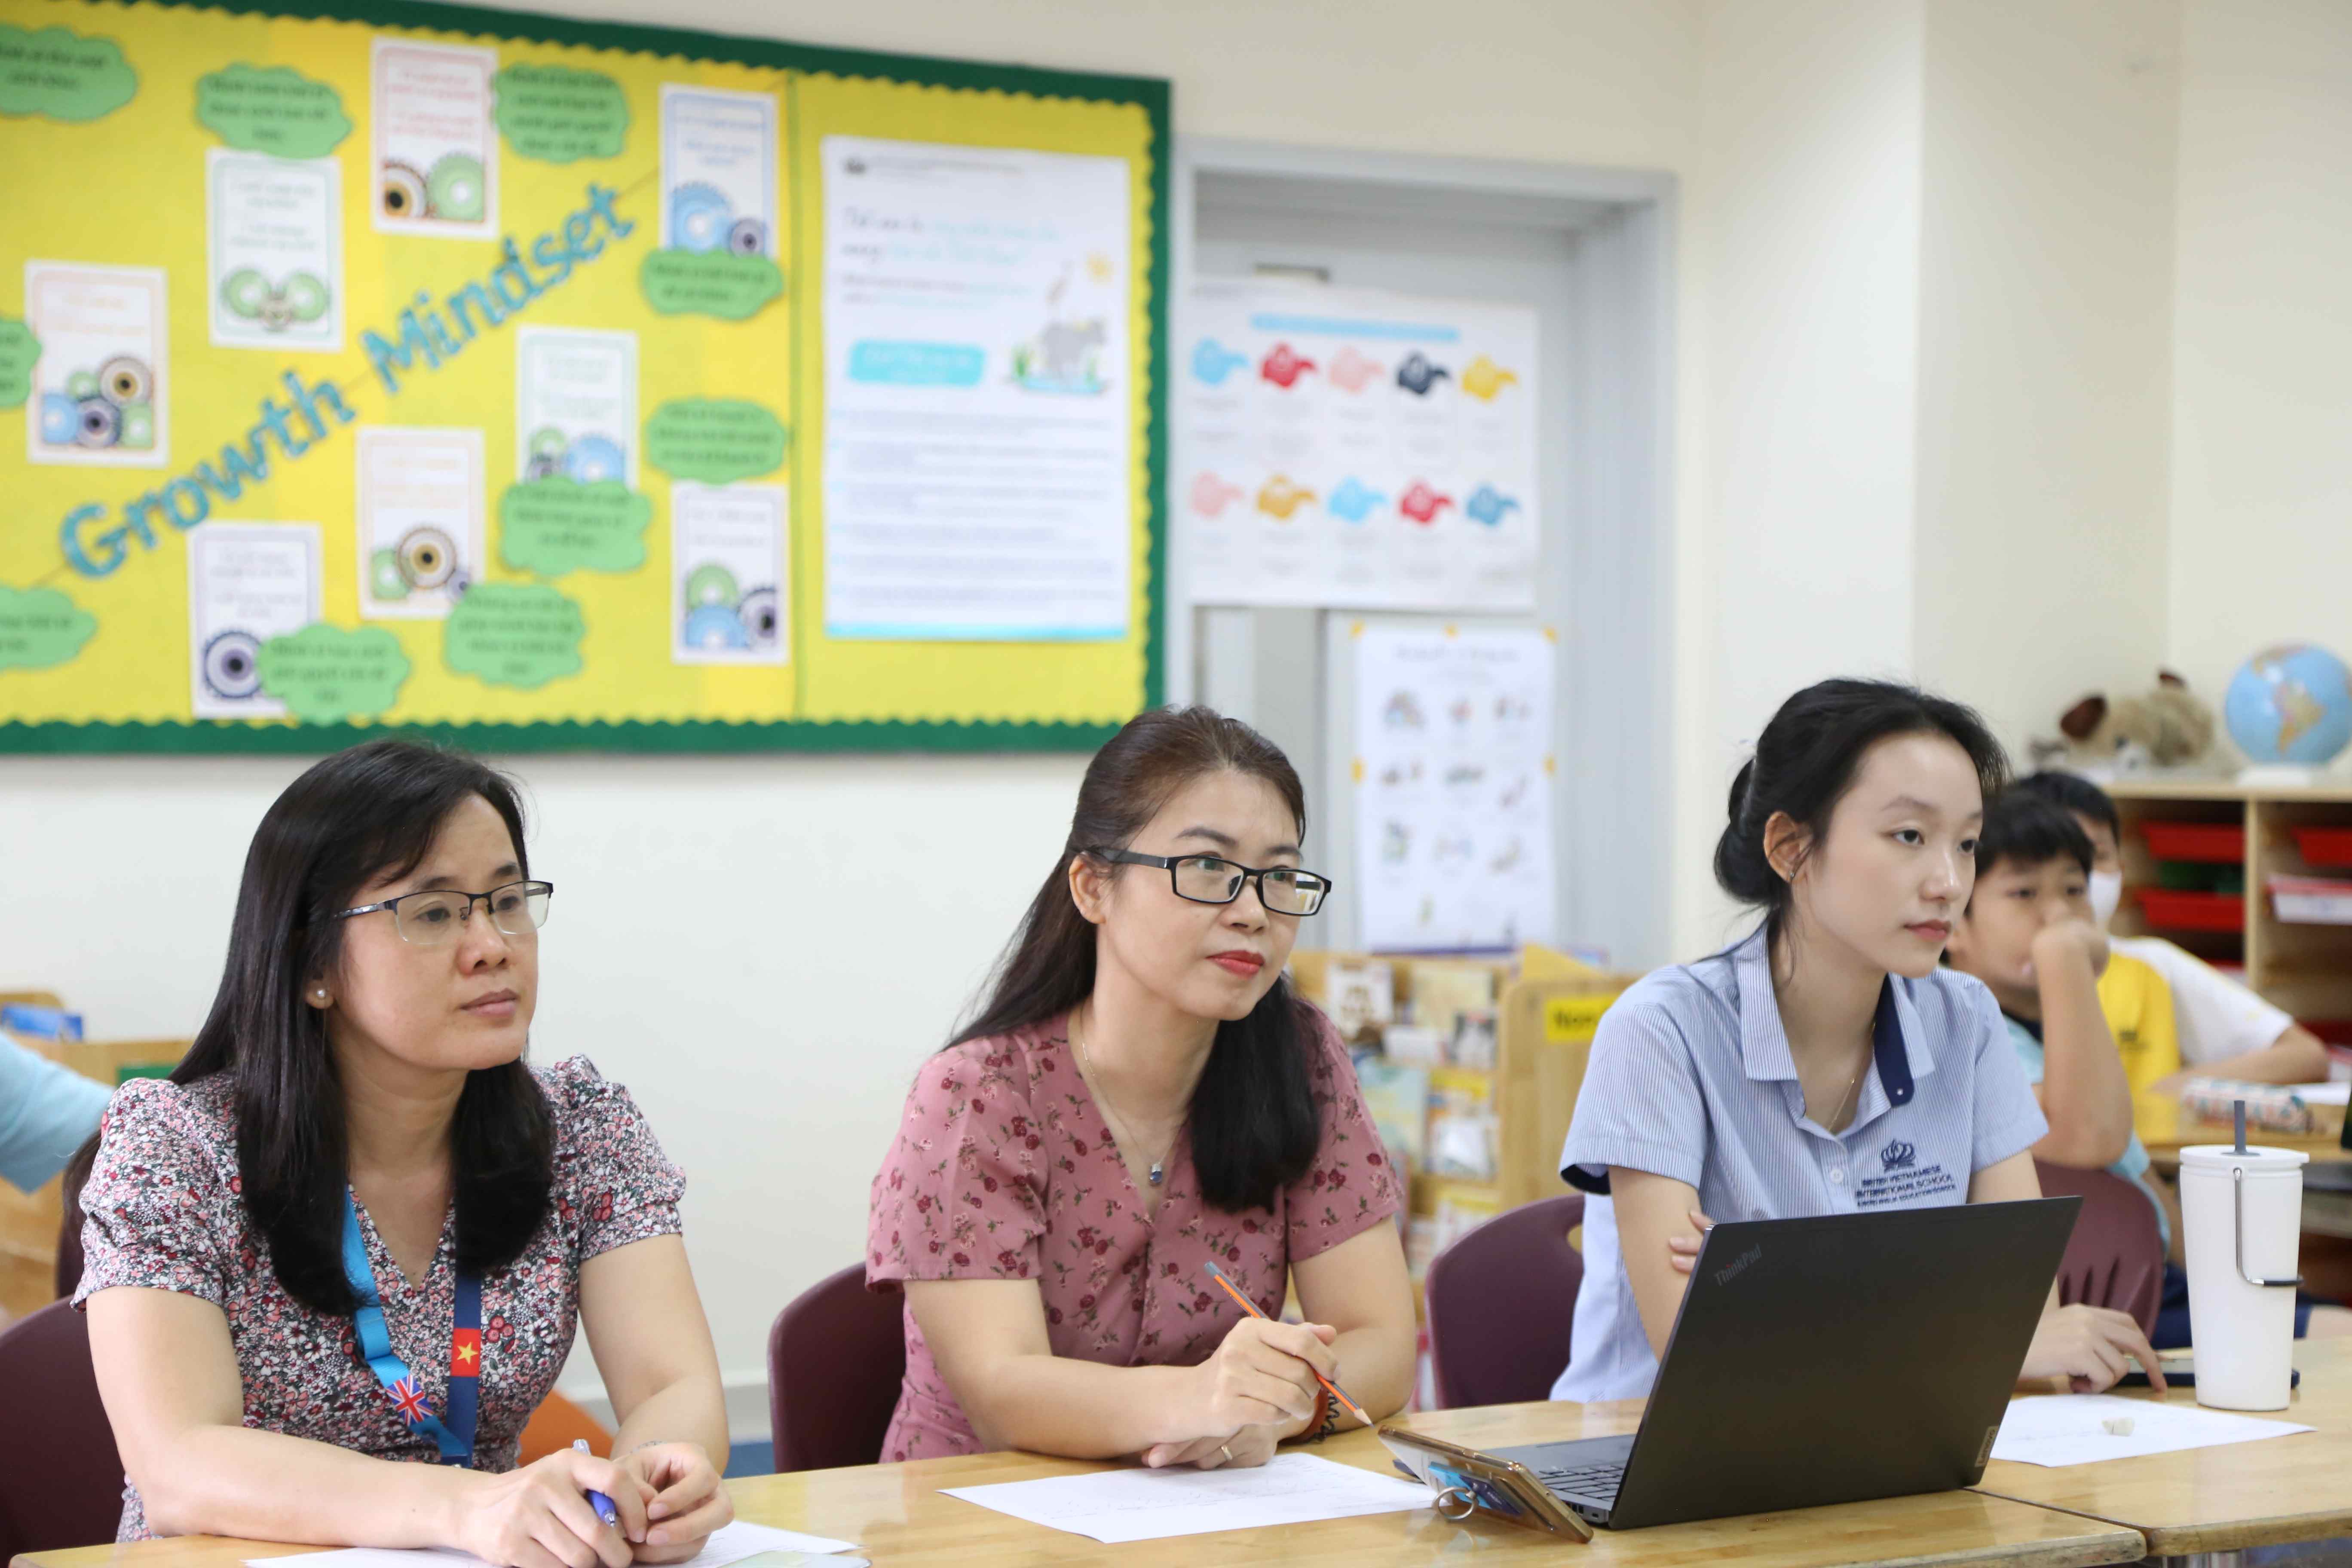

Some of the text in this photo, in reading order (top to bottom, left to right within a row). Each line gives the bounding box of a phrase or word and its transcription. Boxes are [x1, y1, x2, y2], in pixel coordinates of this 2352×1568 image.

[59, 182, 636, 579] Growth Mindset
[1713, 1242, 1762, 1286] ThinkPad
[1977, 1429, 1995, 1464] Lenovo
